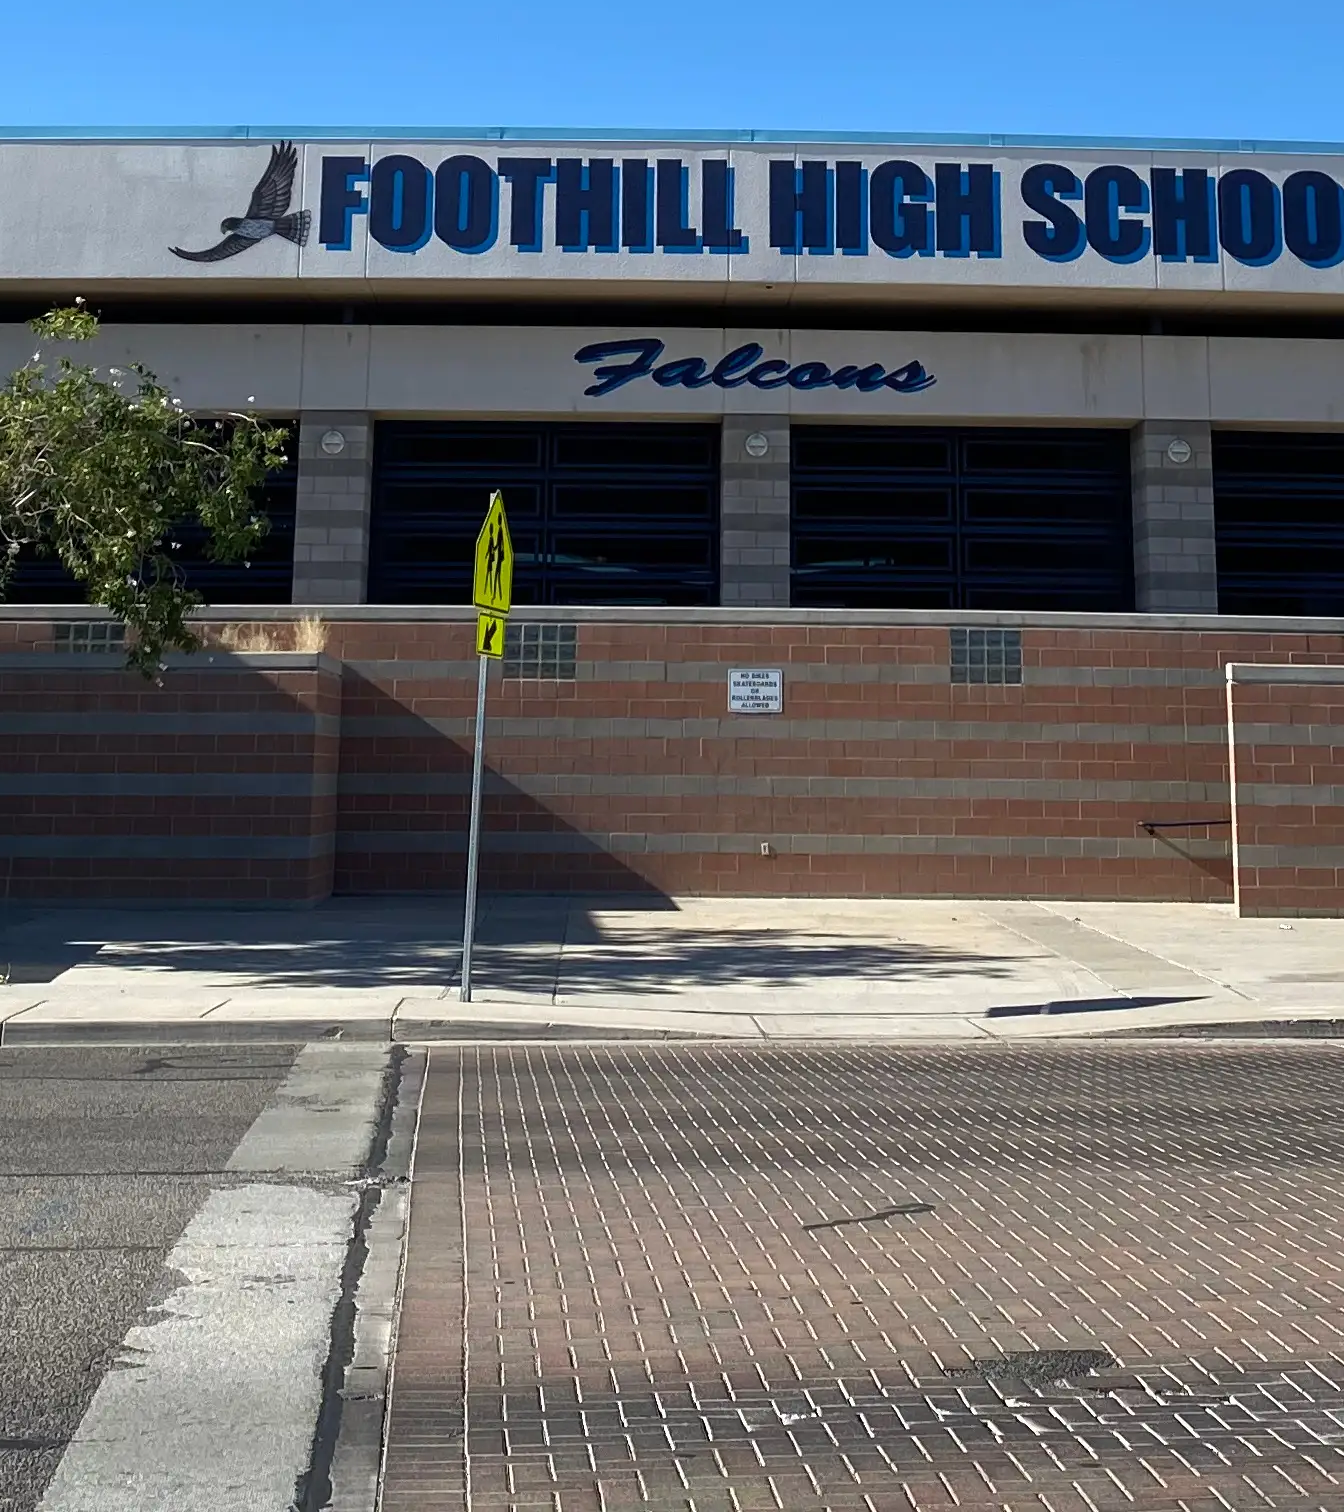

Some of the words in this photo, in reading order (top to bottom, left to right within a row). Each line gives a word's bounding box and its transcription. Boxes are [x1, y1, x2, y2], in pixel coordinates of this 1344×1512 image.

[319, 155, 749, 255] FOOTHILL
[769, 159, 1002, 259] HIGH
[574, 338, 938, 397] Falcons
[732, 680, 777, 688] SKATEBOARDS
